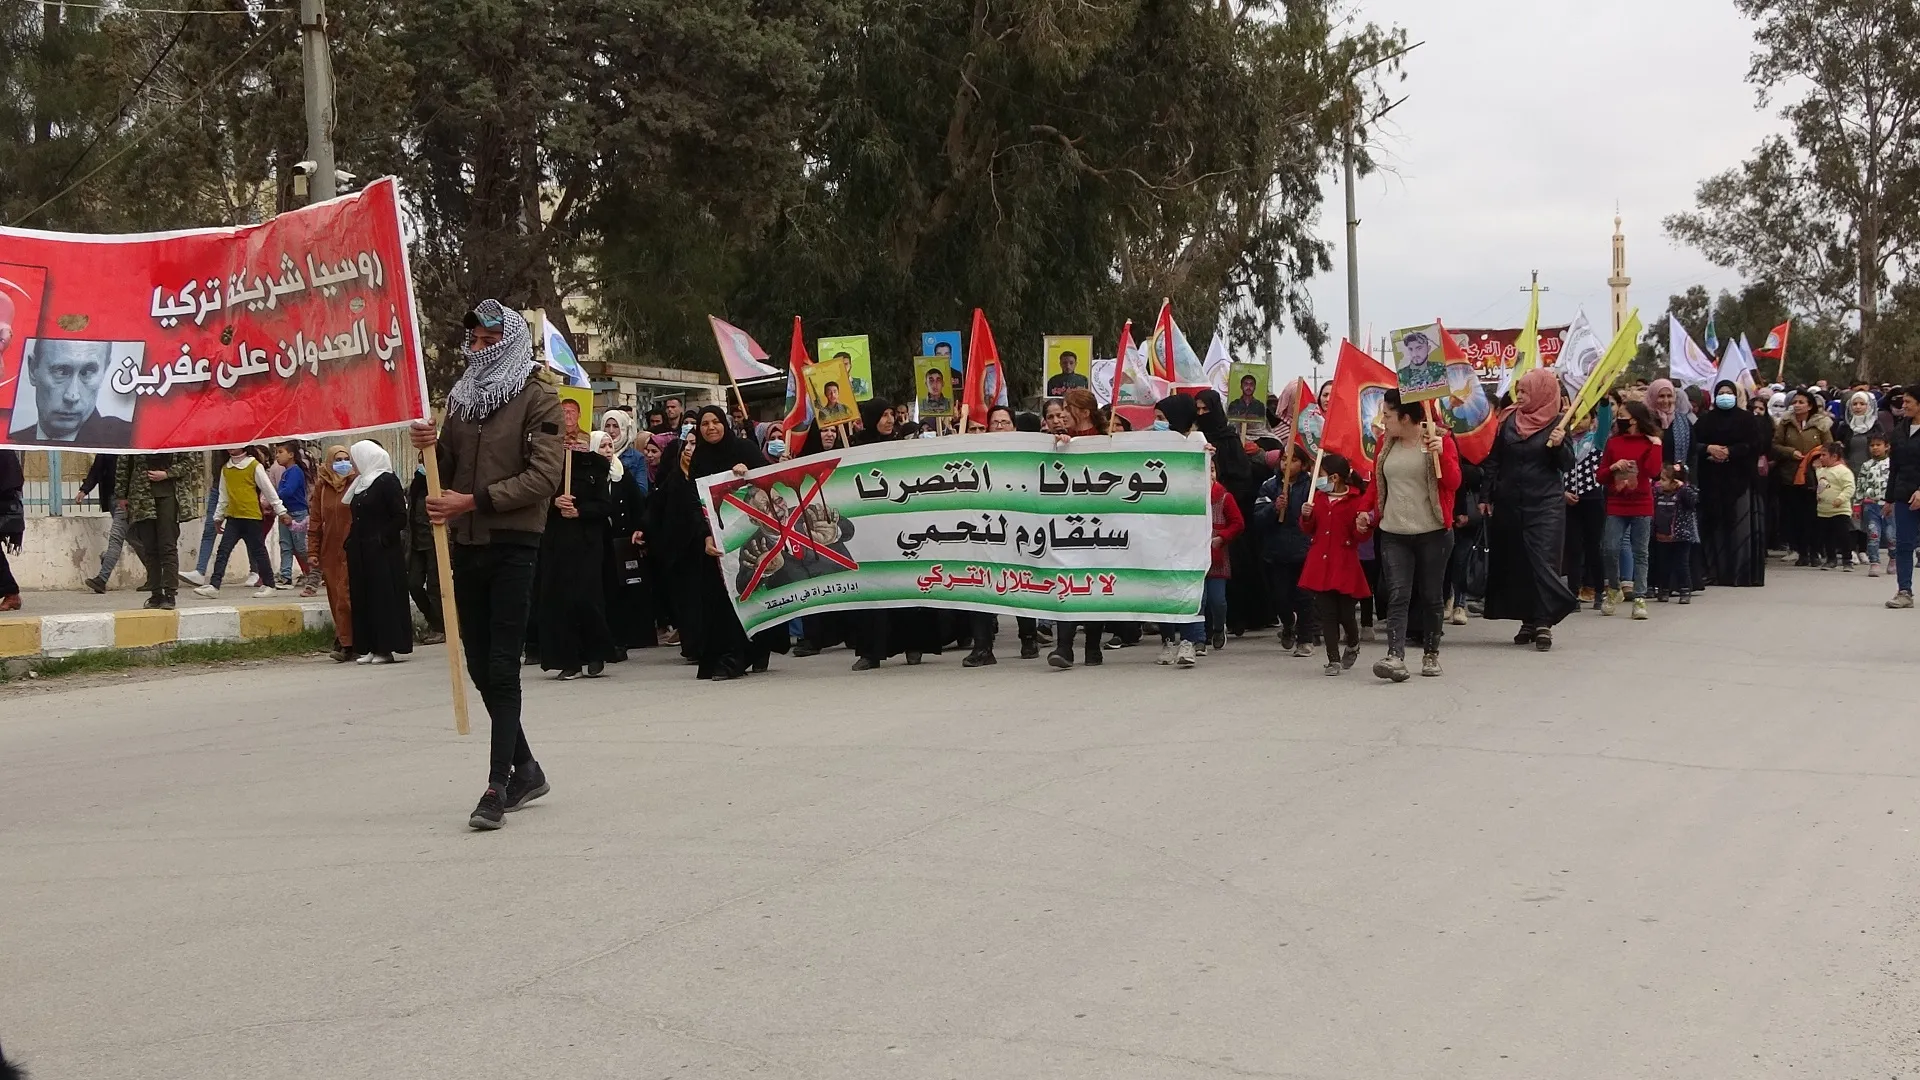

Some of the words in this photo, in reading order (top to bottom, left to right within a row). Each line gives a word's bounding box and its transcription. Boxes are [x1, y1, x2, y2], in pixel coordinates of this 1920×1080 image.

[227, 252, 305, 312] شريكة
[307, 249, 383, 297] روسيا
[151, 278, 221, 328] تركيا
[275, 318, 370, 377] العدوان
[374, 305, 402, 371] في
[110, 343, 211, 397] عفرين
[217, 341, 269, 388] على
[854, 459, 992, 504] انتصرنا
[1039, 459, 1169, 501] توحدنا
[897, 512, 1007, 559] لنحمي
[1015, 514, 1130, 558] سنقاوم
[764, 593, 798, 610] الطبقة
[799, 589, 811, 603] في
[916, 563, 992, 594] التركي
[1099, 573, 1116, 595] لا
